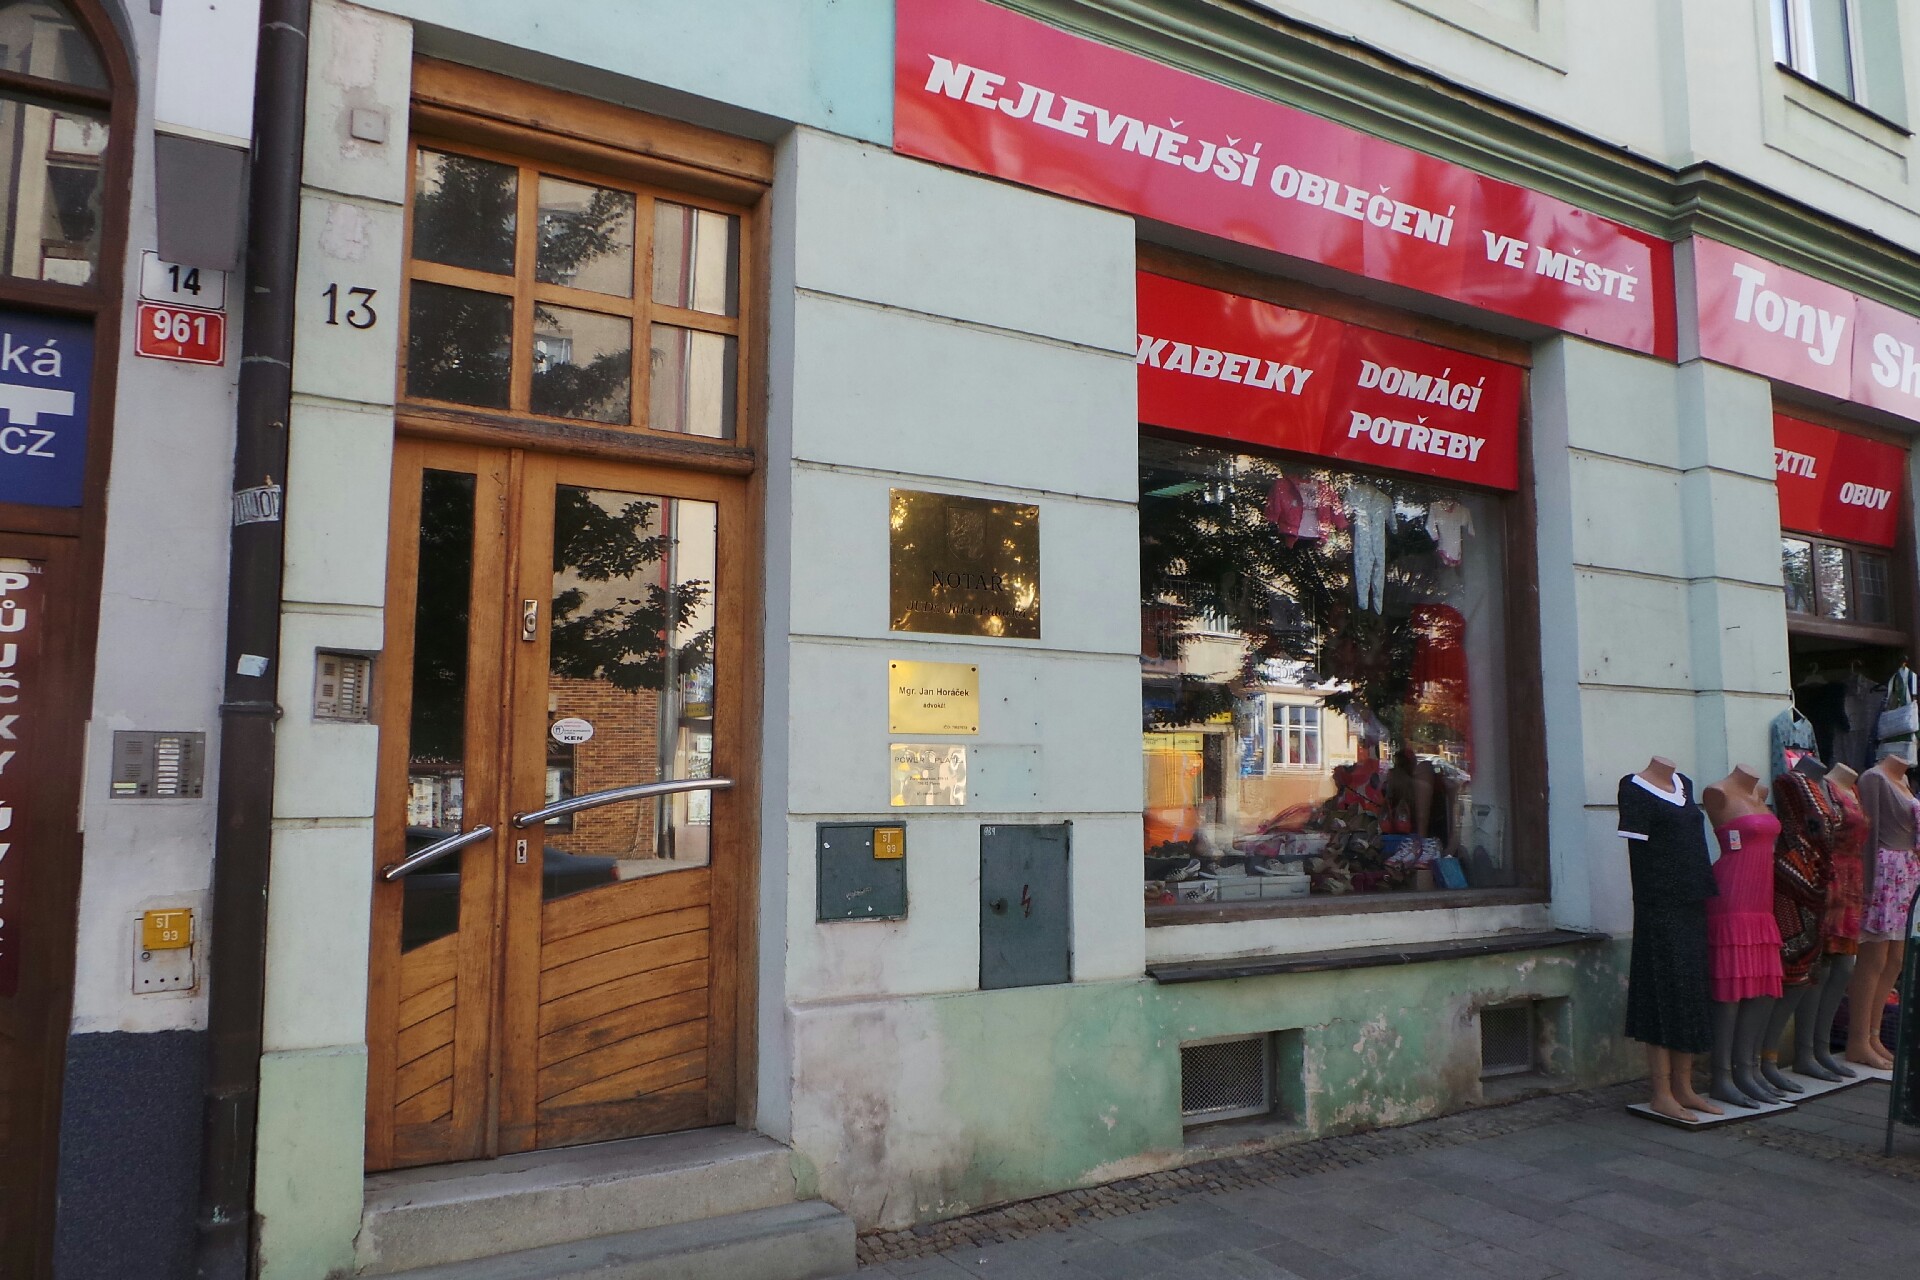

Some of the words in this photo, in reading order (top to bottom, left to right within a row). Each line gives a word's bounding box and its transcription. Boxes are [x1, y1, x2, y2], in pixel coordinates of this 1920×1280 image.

[924, 53, 1262, 187] NEJLEVNĚJŠÍ
[1270, 164, 1456, 246] OBLEČENÍ
[1482, 229, 1529, 269] VE
[1536, 246, 1639, 302] MĚSTĚ
[168, 265, 202, 295] 14
[153, 309, 206, 345] 961
[322, 283, 378, 329] 13
[1732, 262, 1846, 366] Tony
[1136, 333, 1313, 395] KABELKY
[1357, 359, 1485, 413] DOMÁCÍ
[1347, 410, 1486, 462] POTŘEBY
[1839, 482, 1891, 510] OBUV
[899, 686, 917, 697] Mgr.
[919, 687, 934, 696] Jan
[936, 687, 970, 697] Horáček
[162, 930, 178, 941] 93
